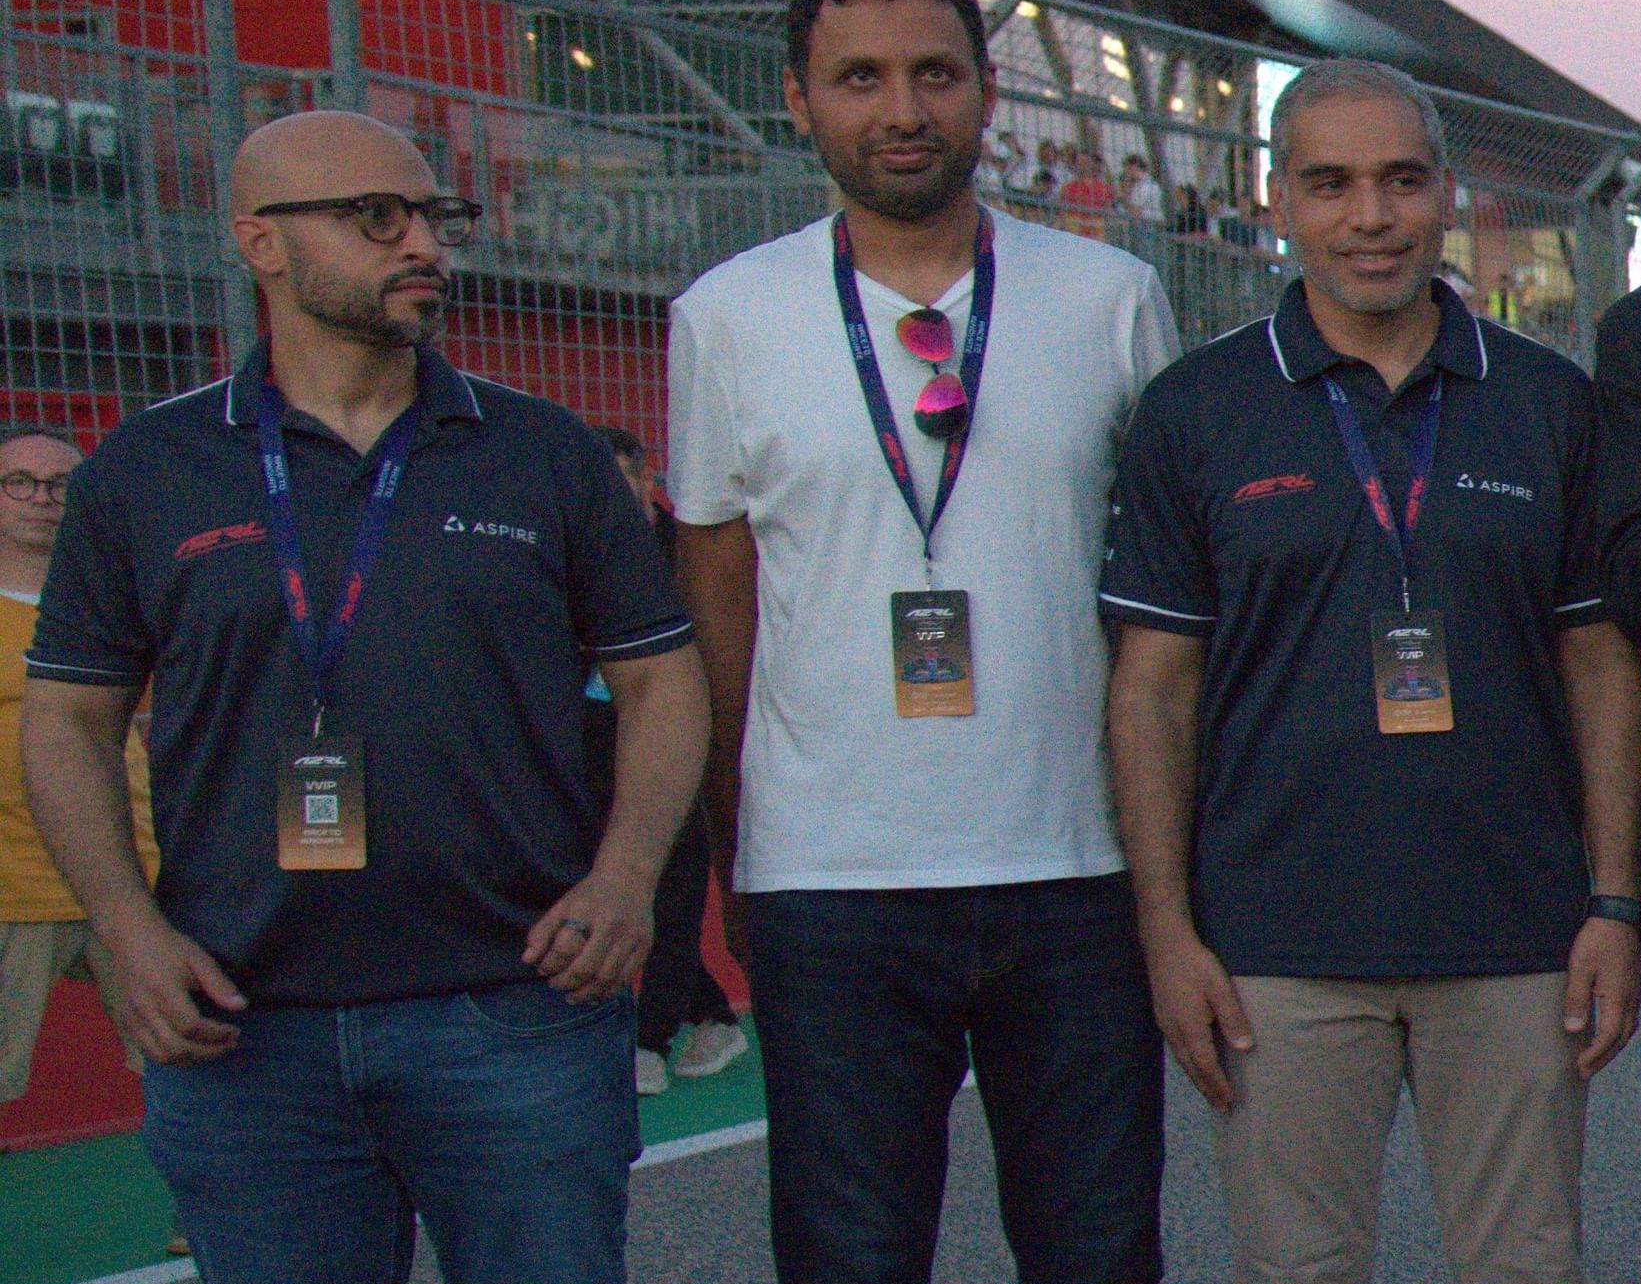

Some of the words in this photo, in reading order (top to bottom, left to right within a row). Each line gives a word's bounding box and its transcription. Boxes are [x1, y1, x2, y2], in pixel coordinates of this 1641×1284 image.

[1480, 479, 1534, 502] ASPIRE
[472, 522, 537, 544] ASPIRE
[305, 781, 338, 791] VVIP
